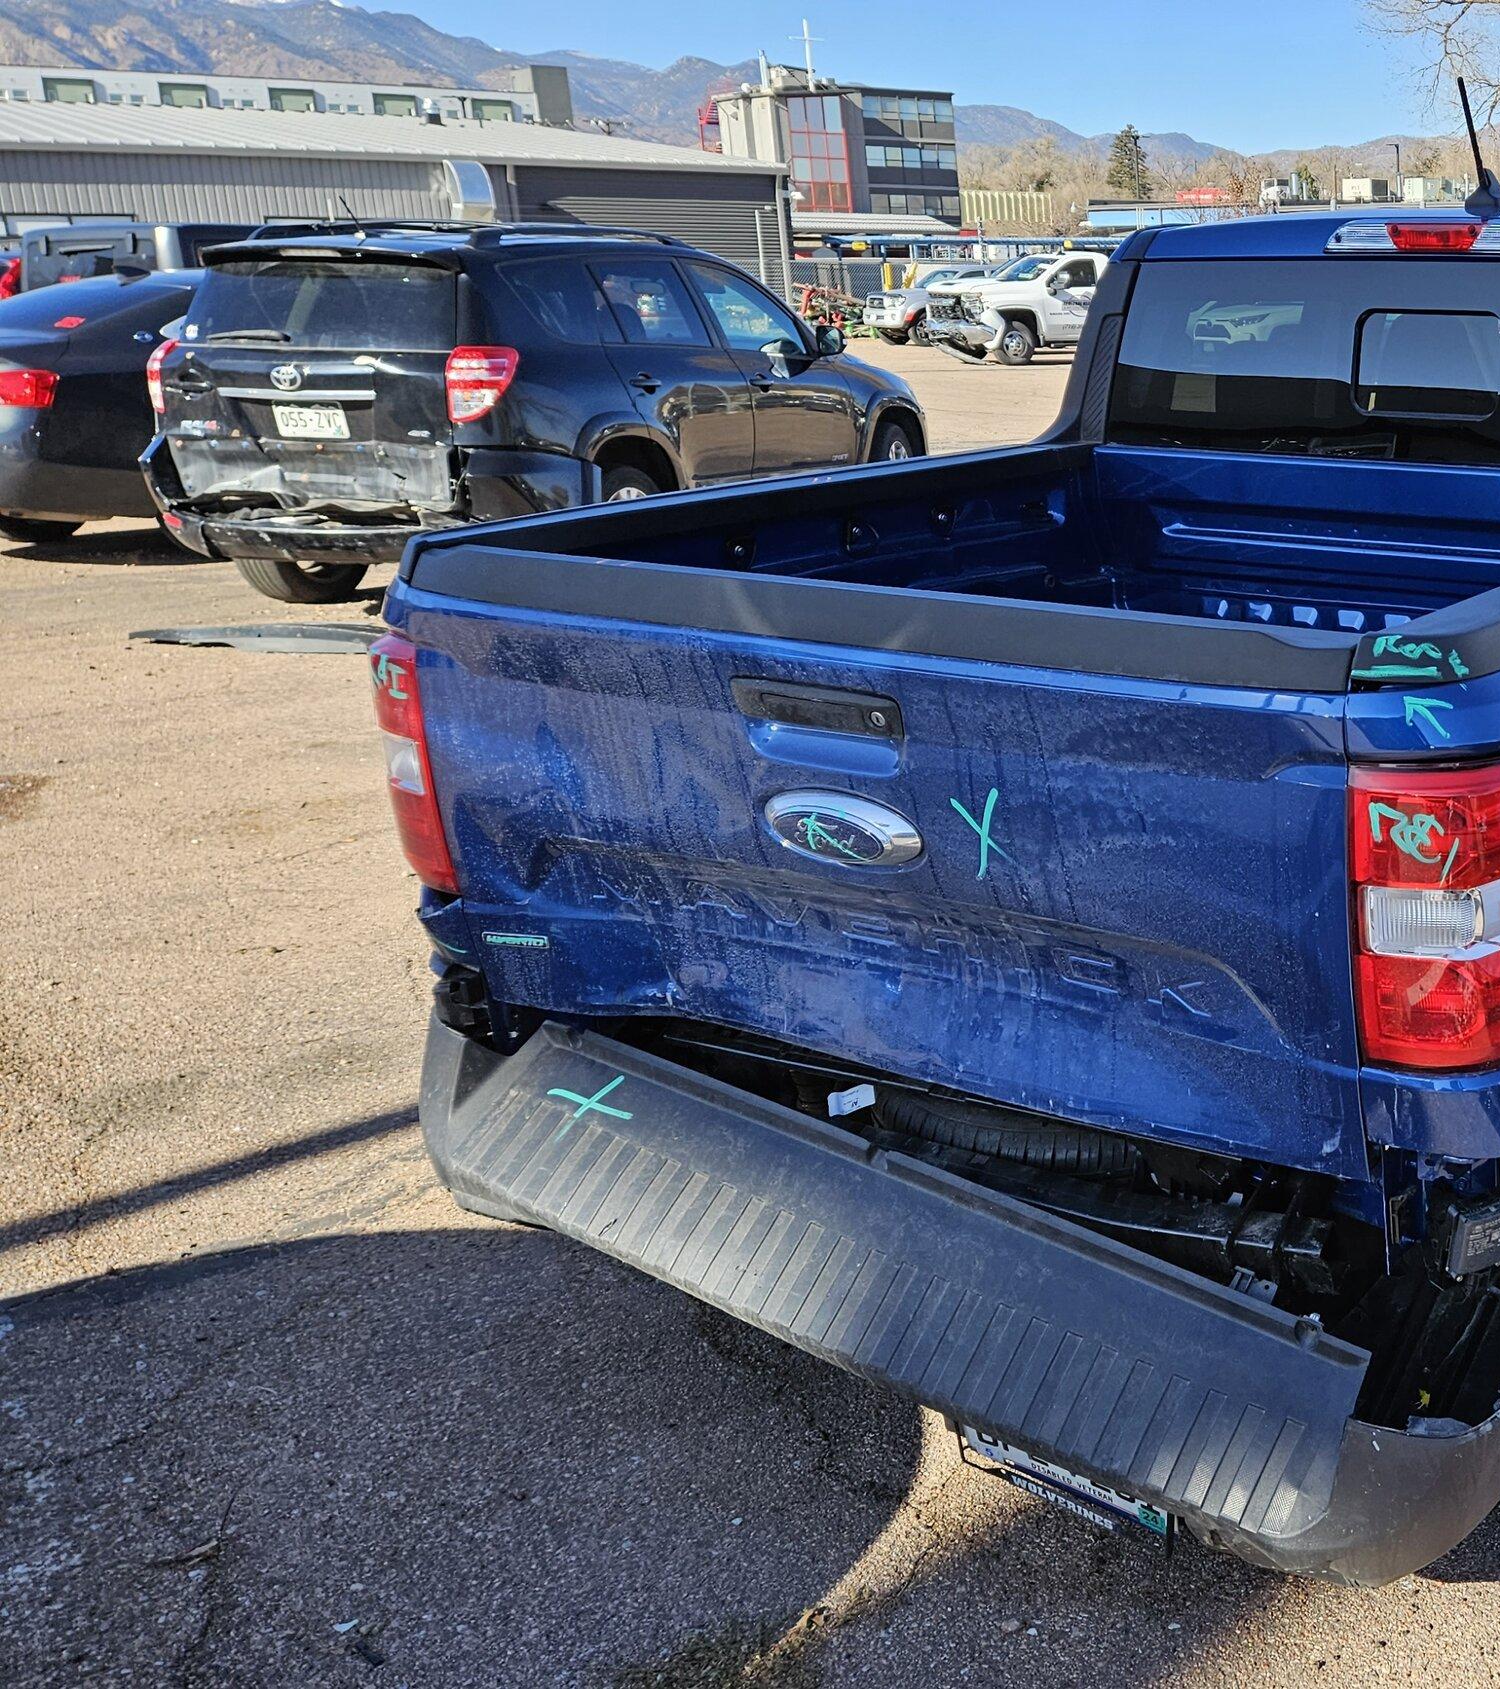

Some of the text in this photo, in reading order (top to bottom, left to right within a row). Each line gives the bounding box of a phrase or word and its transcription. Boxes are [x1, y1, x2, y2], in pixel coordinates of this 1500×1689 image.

[794, 816, 856, 853] Ford
[1031, 1463, 1113, 1503] DISABLED VETERAN
[1011, 1475, 1114, 1530] WOLVERINES
[1142, 1511, 1158, 1525] 24
